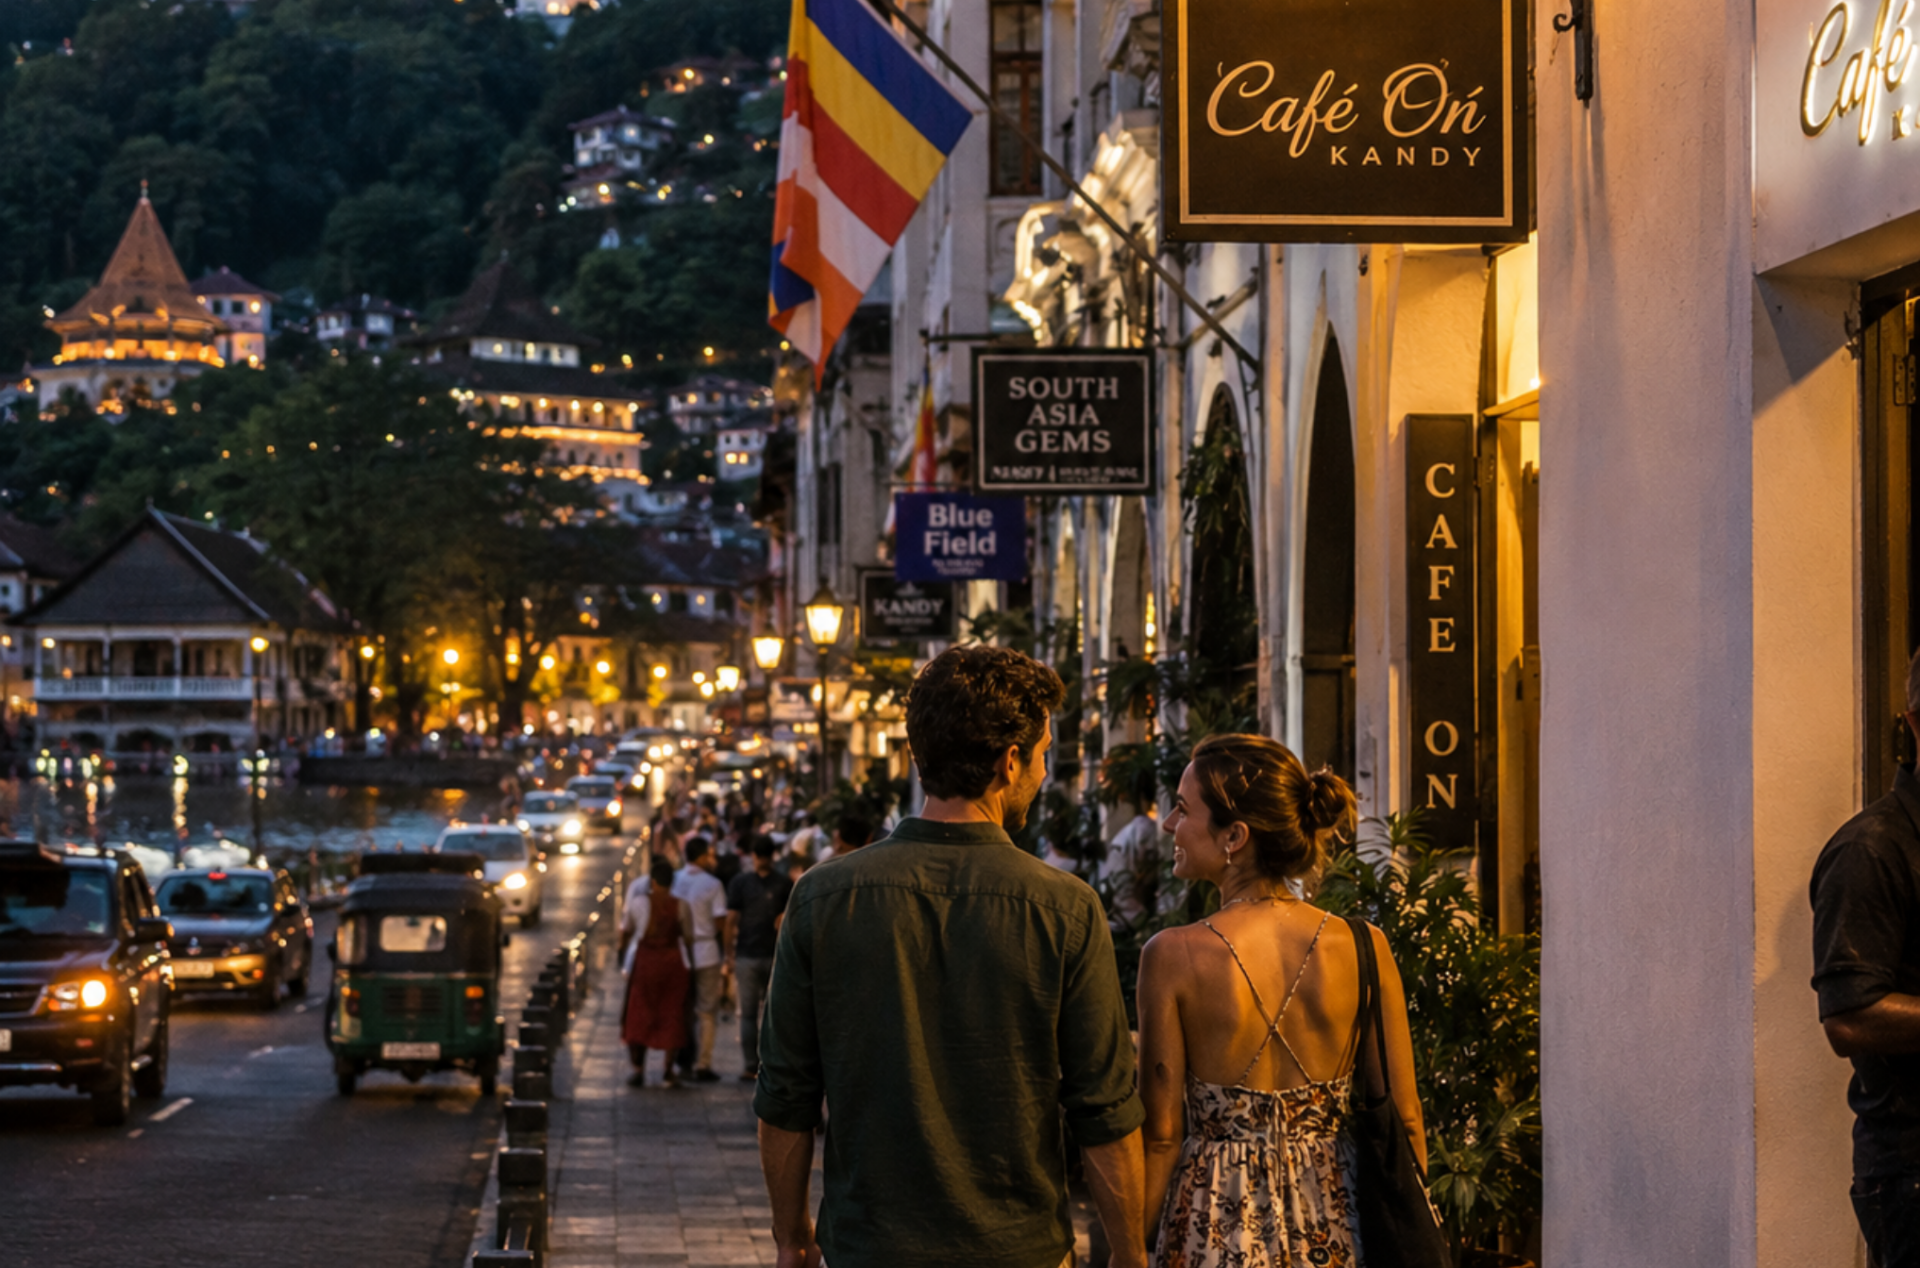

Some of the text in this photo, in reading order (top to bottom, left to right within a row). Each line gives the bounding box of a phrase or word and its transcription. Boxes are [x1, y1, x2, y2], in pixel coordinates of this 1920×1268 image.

[1800, 0, 1918, 147] Café
[1207, 60, 1358, 158] Café
[1330, 145, 1481, 167] KANDY
[1009, 376, 1119, 400] SOUTH
[1028, 403, 1100, 425] ASIA
[1014, 430, 1111, 453] GEMS
[928, 503, 994, 529] Blue
[923, 530, 997, 556] Field
[873, 598, 944, 616] KANDY
[1424, 463, 1459, 810] CAFE ON
